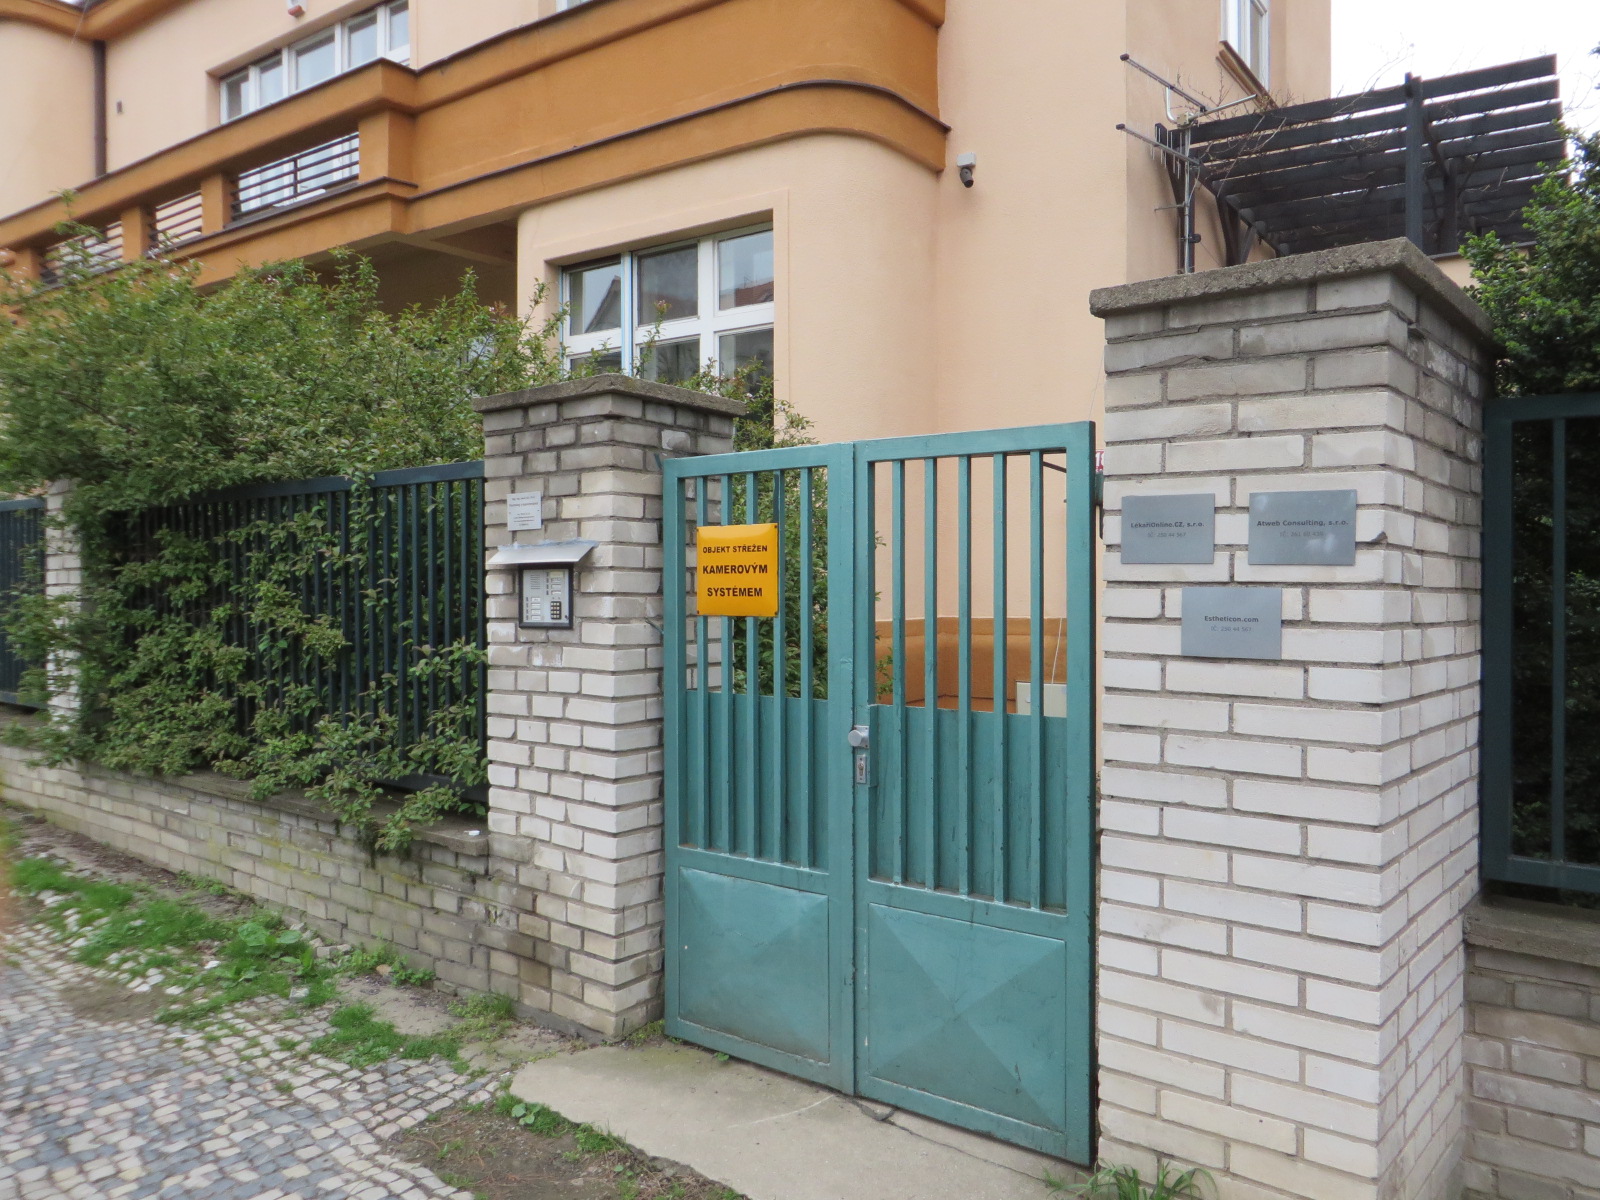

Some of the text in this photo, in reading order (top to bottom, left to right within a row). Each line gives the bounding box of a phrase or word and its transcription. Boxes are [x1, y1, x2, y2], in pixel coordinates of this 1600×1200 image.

[1282, 519, 1326, 527] Consulting,
[702, 543, 768, 554] OBJEKT STŘEŽEN
[702, 562, 768, 575] KAMEROVÝM
[707, 585, 763, 597] SYSTÉMEM
[1204, 615, 1259, 623] Estheticon.com
